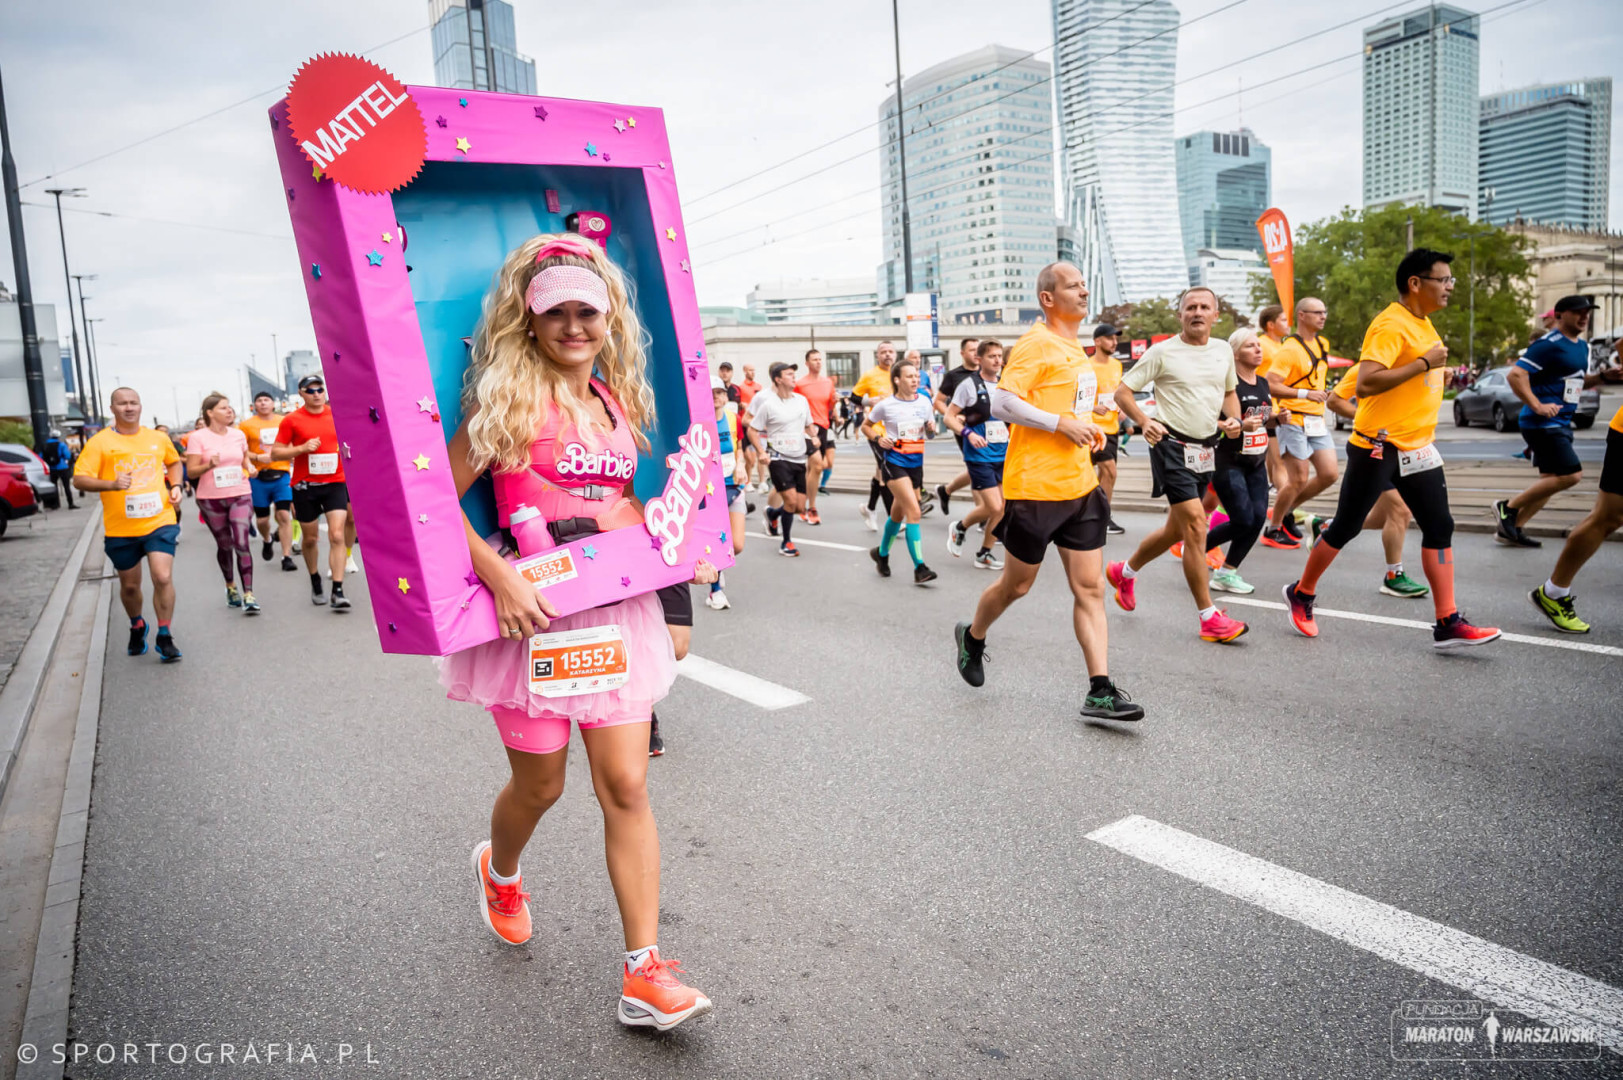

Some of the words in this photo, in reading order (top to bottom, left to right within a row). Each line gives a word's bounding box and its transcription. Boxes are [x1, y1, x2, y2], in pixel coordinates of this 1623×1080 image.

[301, 80, 409, 169] MATTEL
[556, 442, 634, 479] Barbie
[645, 423, 712, 566] Barbie
[530, 560, 565, 579] 15552
[560, 646, 616, 670] 15552
[569, 667, 606, 676] KATARZYNA
